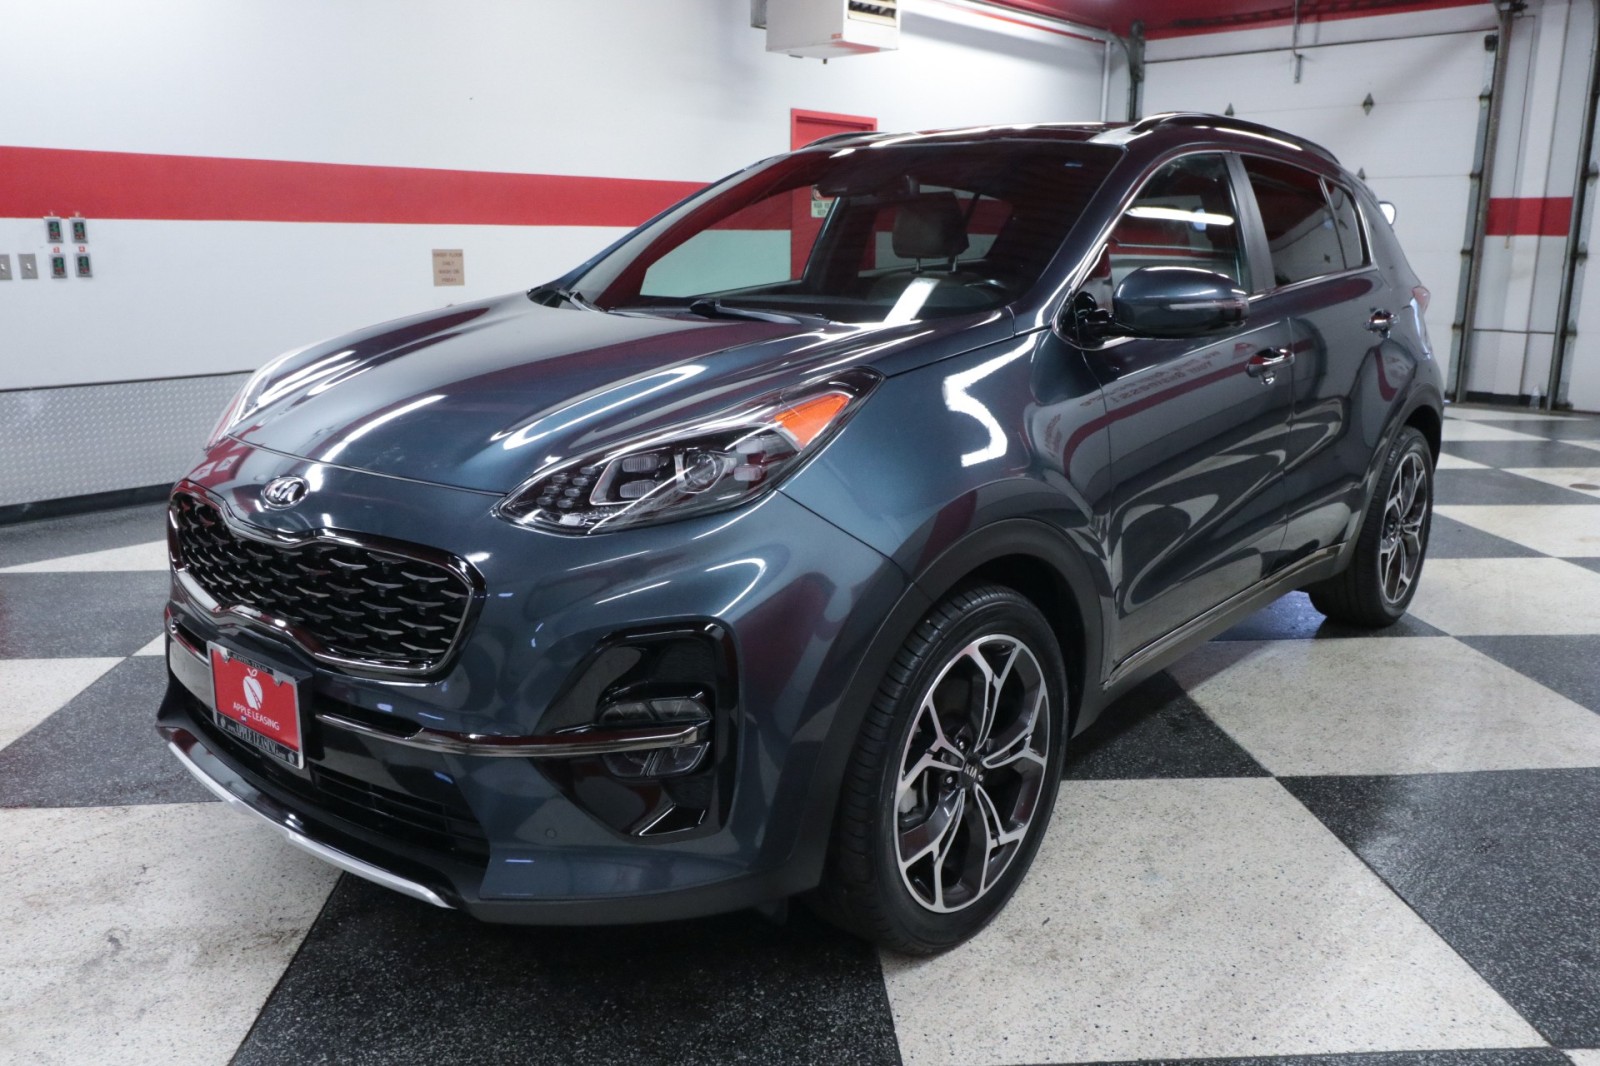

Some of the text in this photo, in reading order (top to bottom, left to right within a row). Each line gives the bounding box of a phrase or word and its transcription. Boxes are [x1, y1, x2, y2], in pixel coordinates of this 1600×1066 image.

[233, 701, 252, 718] APPLE
[252, 710, 280, 731] LEASING
[964, 763, 978, 779] KIA
